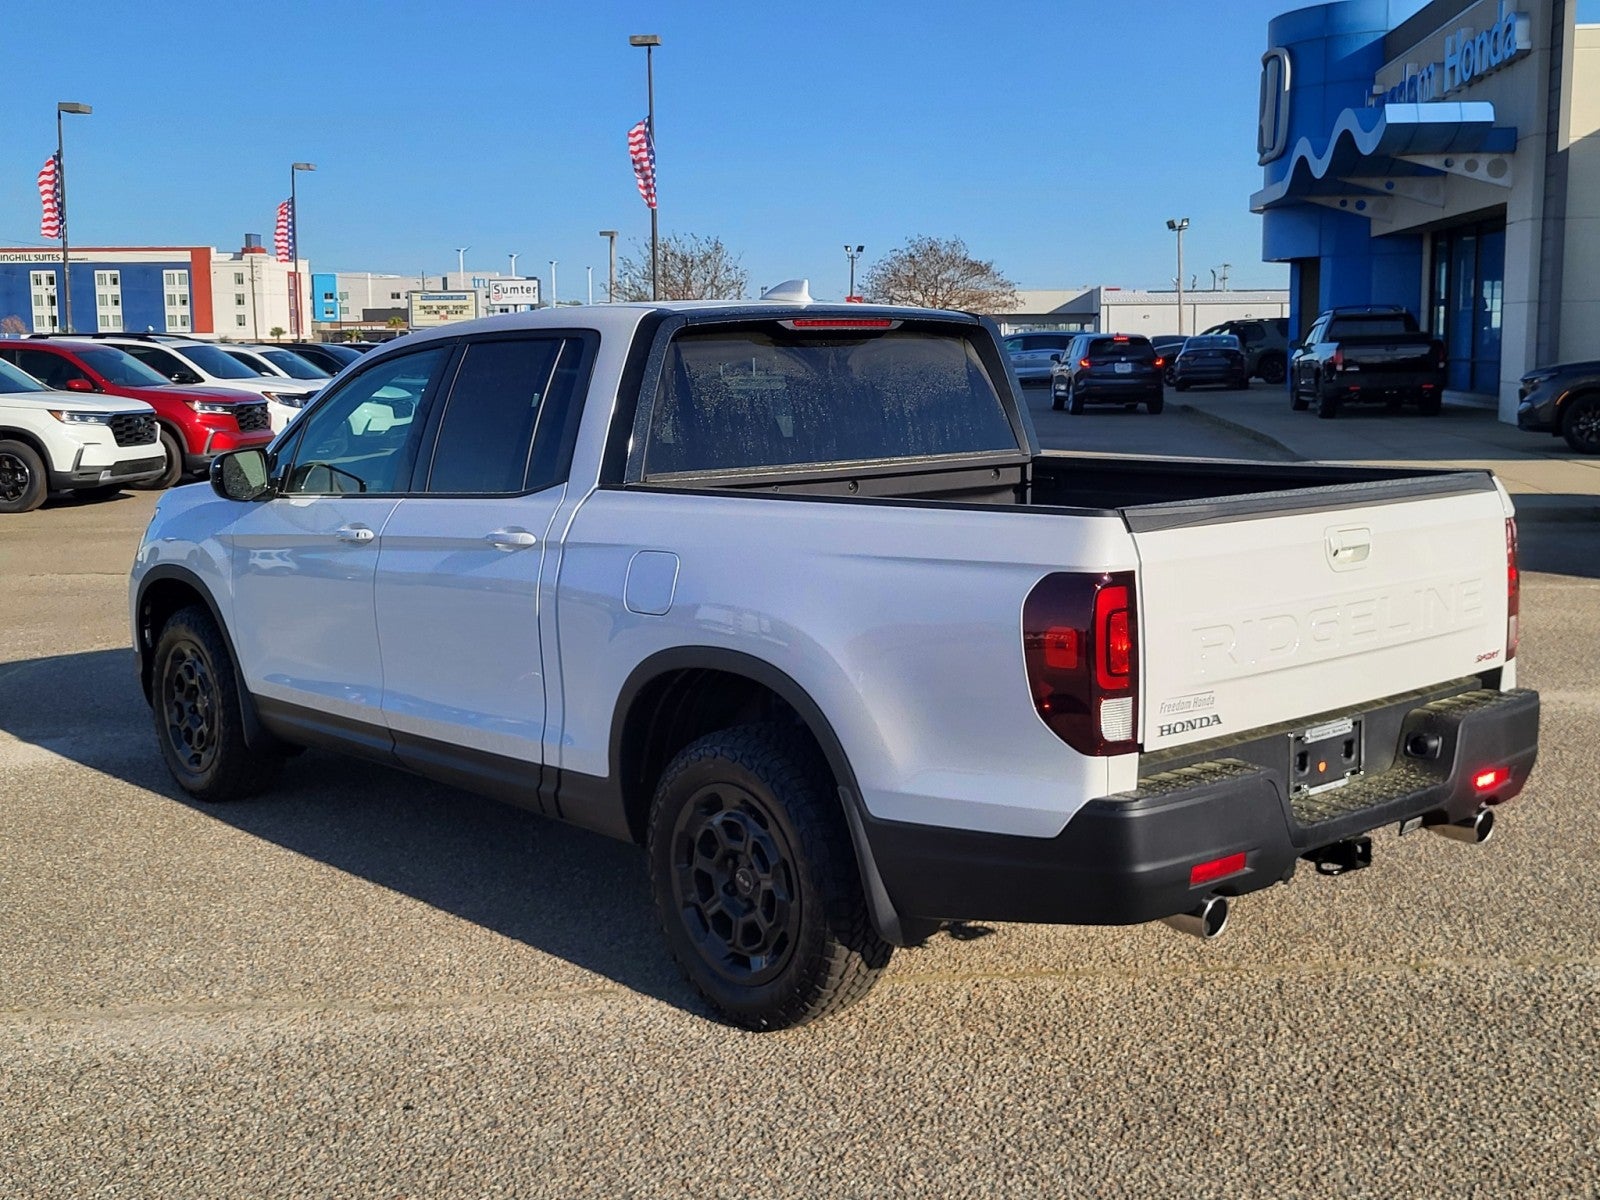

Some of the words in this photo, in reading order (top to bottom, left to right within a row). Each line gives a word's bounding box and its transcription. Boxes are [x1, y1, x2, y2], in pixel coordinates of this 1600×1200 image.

[1444, 0, 1520, 93] Honda
[34, 253, 61, 262] SUITES
[493, 284, 537, 295] Sumter
[1190, 577, 1485, 674] RIDGELINE
[1159, 699, 1192, 714] Freedom
[1193, 694, 1215, 709] Honda
[1157, 713, 1222, 737] HONDA
